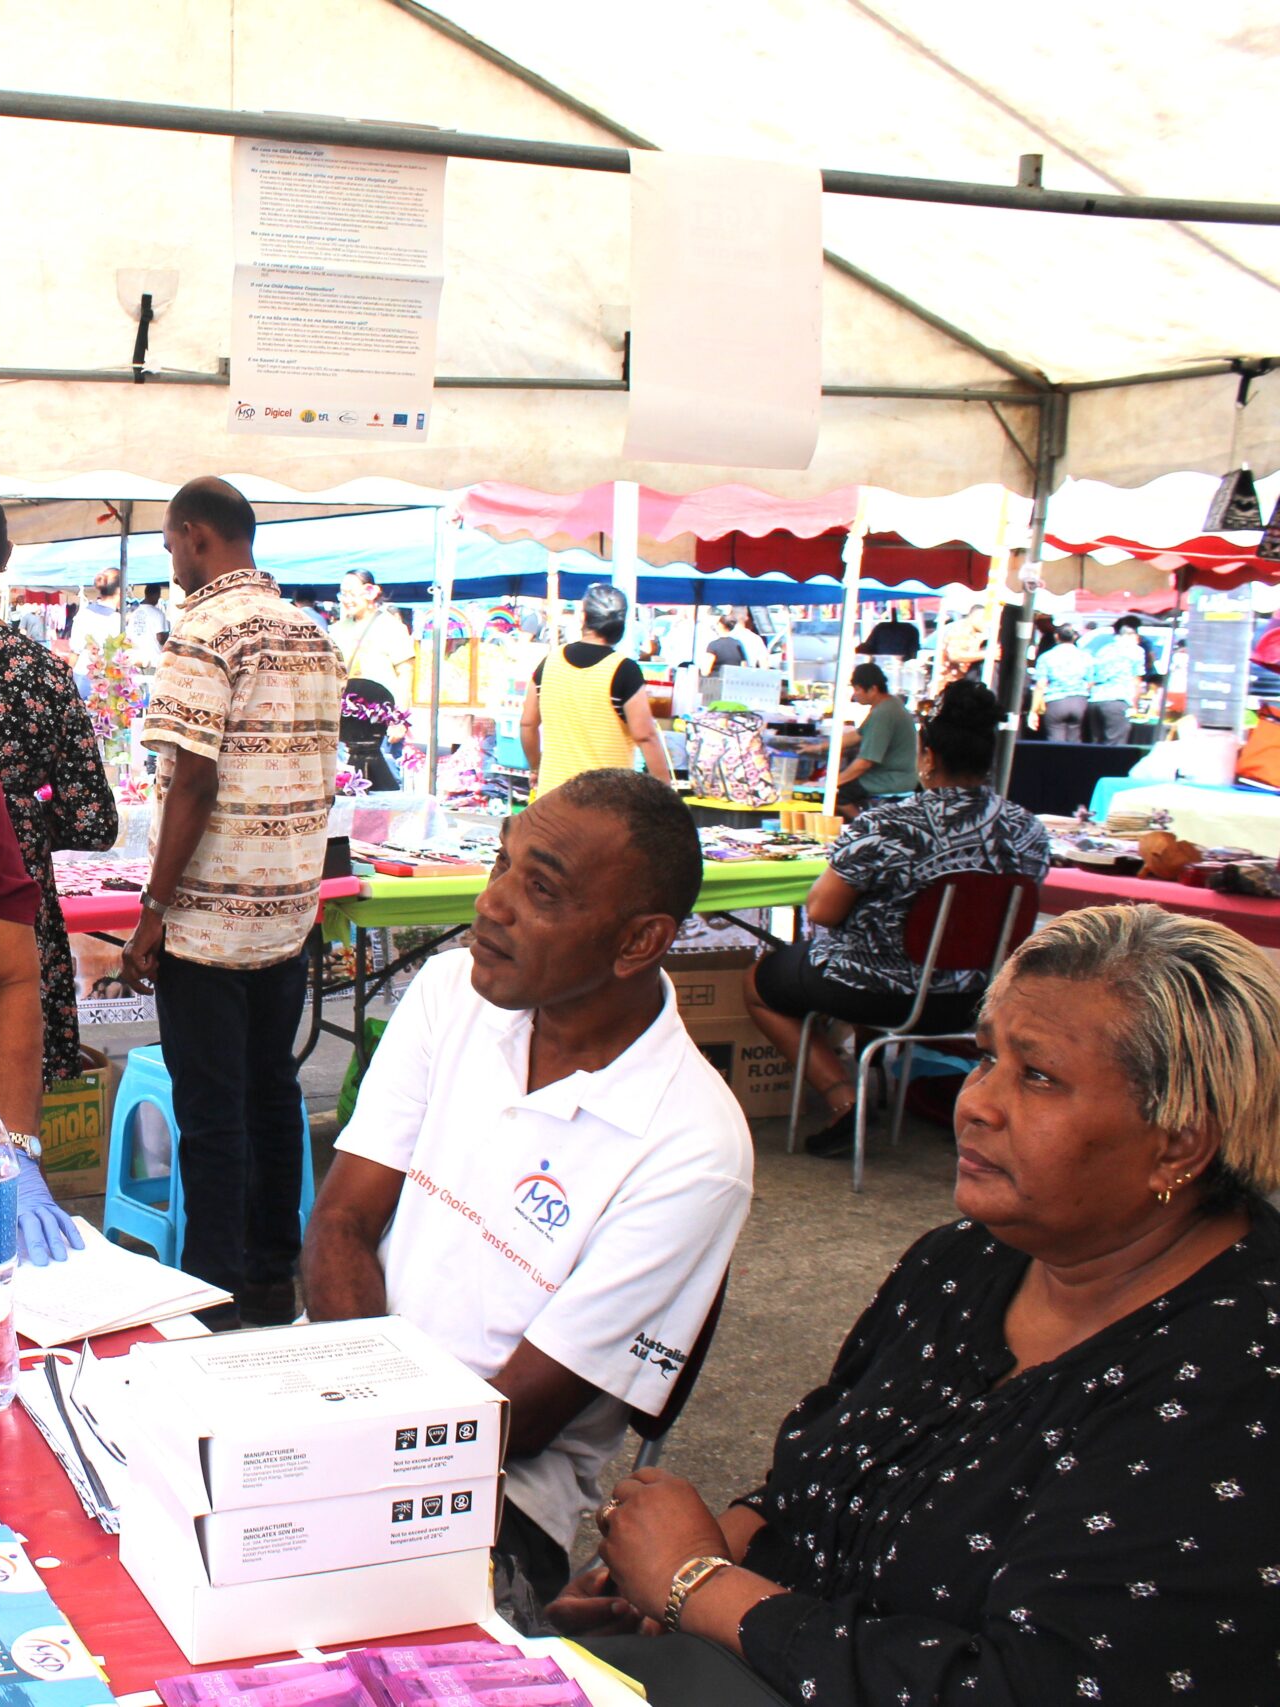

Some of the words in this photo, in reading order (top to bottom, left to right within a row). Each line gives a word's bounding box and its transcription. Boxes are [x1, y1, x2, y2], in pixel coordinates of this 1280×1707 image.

[238, 408, 256, 420] MSP
[265, 407, 292, 418] Digicel
[439, 1189, 482, 1225] Choices
[521, 1182, 570, 1231] MSP
[629, 1343, 648, 1361] Aid
[244, 1448, 295, 1459] MANUFACTURER
[243, 1455, 278, 1466] INNOLATEX
[279, 1454, 293, 1462] SDN
[411, 1457, 431, 1465] exceed
[393, 1464, 426, 1472] temperature
[243, 1522, 293, 1534] MANUFACTURER
[428, 1525, 450, 1533] average
[243, 1531, 277, 1541] INNOLATEX
[390, 1536, 422, 1545] temperature
